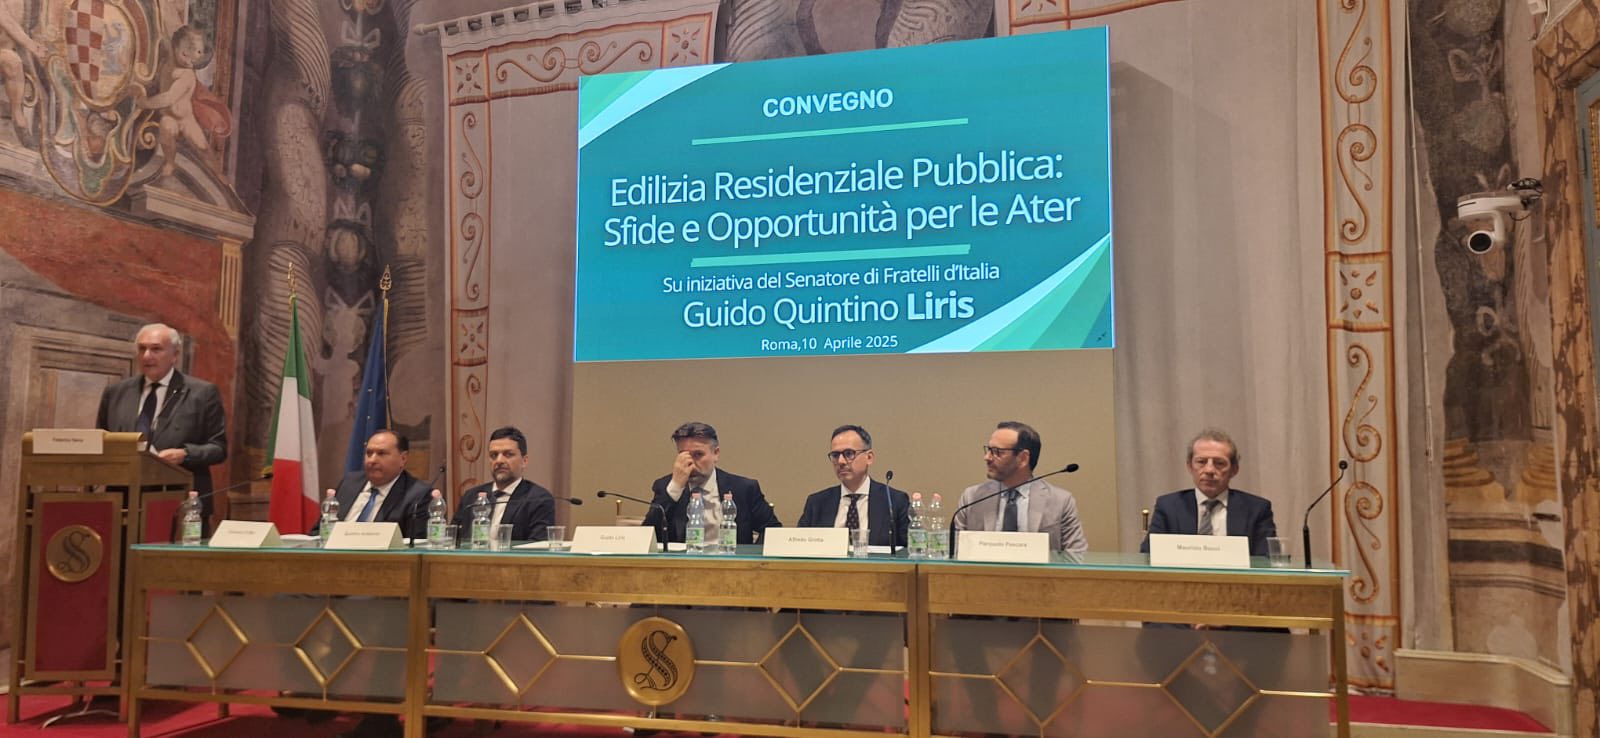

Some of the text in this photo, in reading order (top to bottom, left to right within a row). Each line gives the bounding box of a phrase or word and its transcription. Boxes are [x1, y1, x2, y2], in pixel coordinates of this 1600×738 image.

[762, 88, 894, 118] CONVEGNO
[610, 149, 1063, 208] Edilizia Residenziale Pubblica:
[604, 193, 1082, 248] Sfide e Opportunità per le Ater
[663, 262, 1000, 293] Su iniziativa del Senatore di Fratelli d'Italia
[683, 290, 975, 330] Guido Quintino Liris
[823, 336, 863, 352] Aprile
[865, 335, 899, 348] 2025
